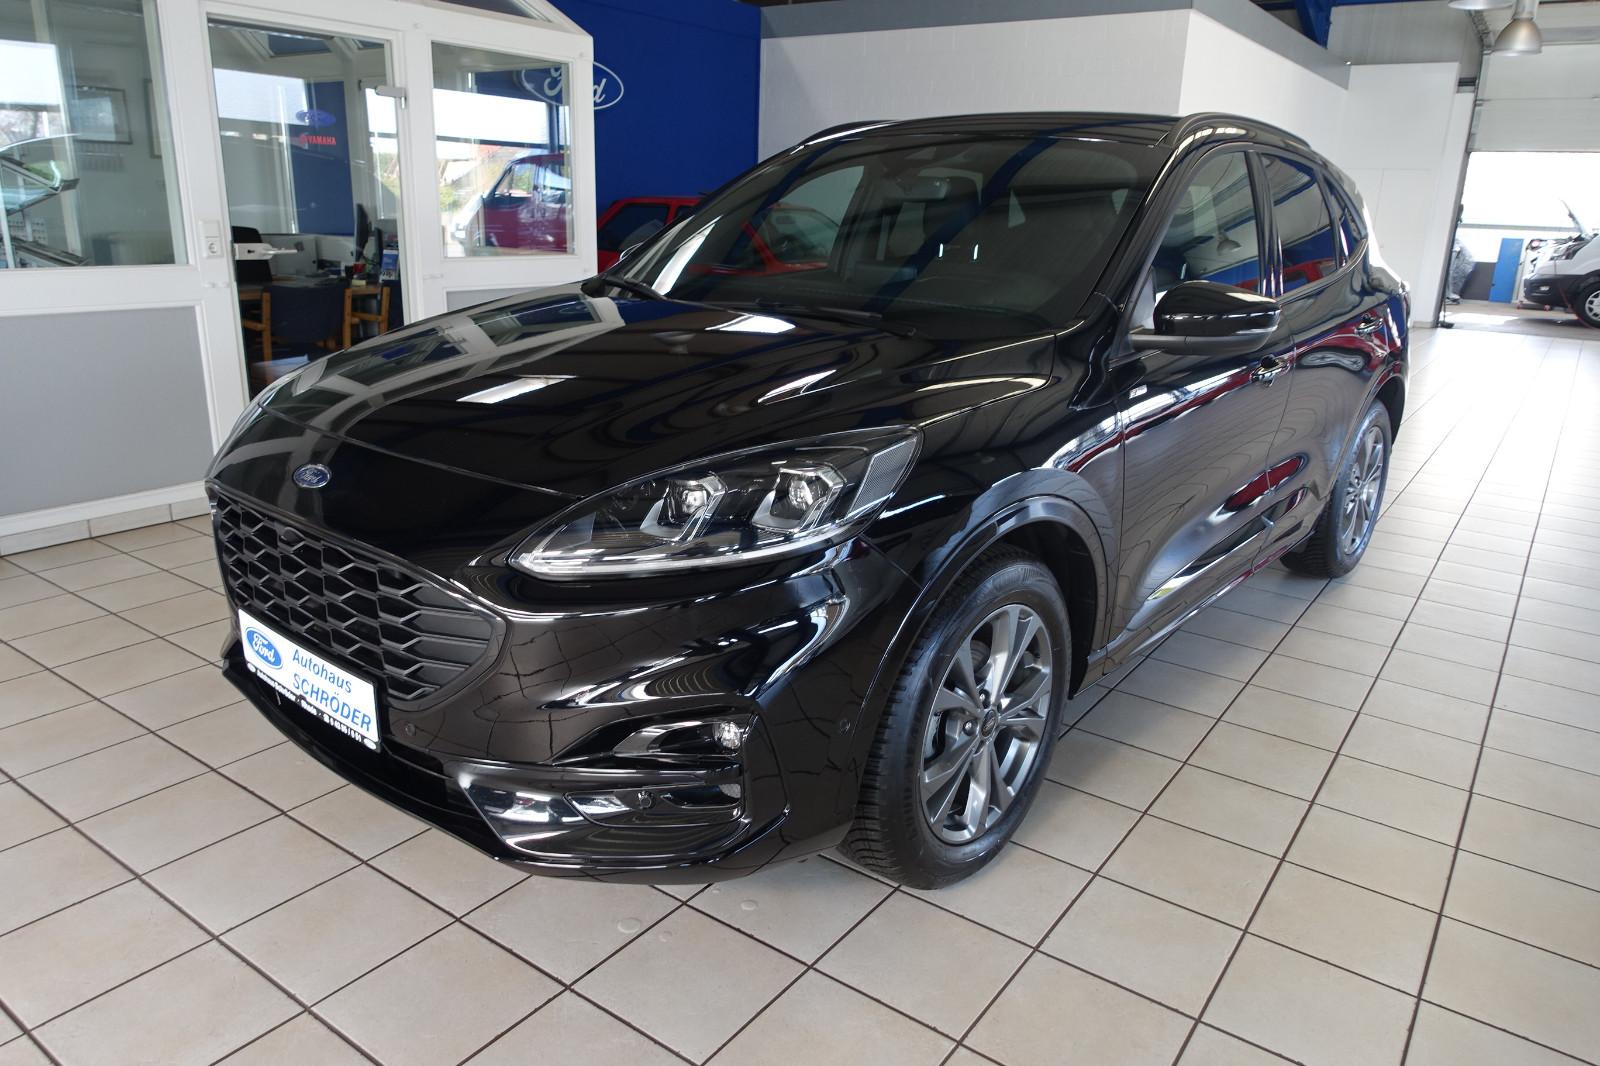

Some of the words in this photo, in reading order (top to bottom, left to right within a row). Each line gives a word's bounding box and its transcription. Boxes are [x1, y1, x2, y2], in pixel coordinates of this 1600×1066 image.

[308, 134, 336, 146] YAMAHA
[251, 632, 276, 663] Ford
[292, 648, 352, 693] Autohaus
[292, 673, 372, 732] SCHRÖDER
